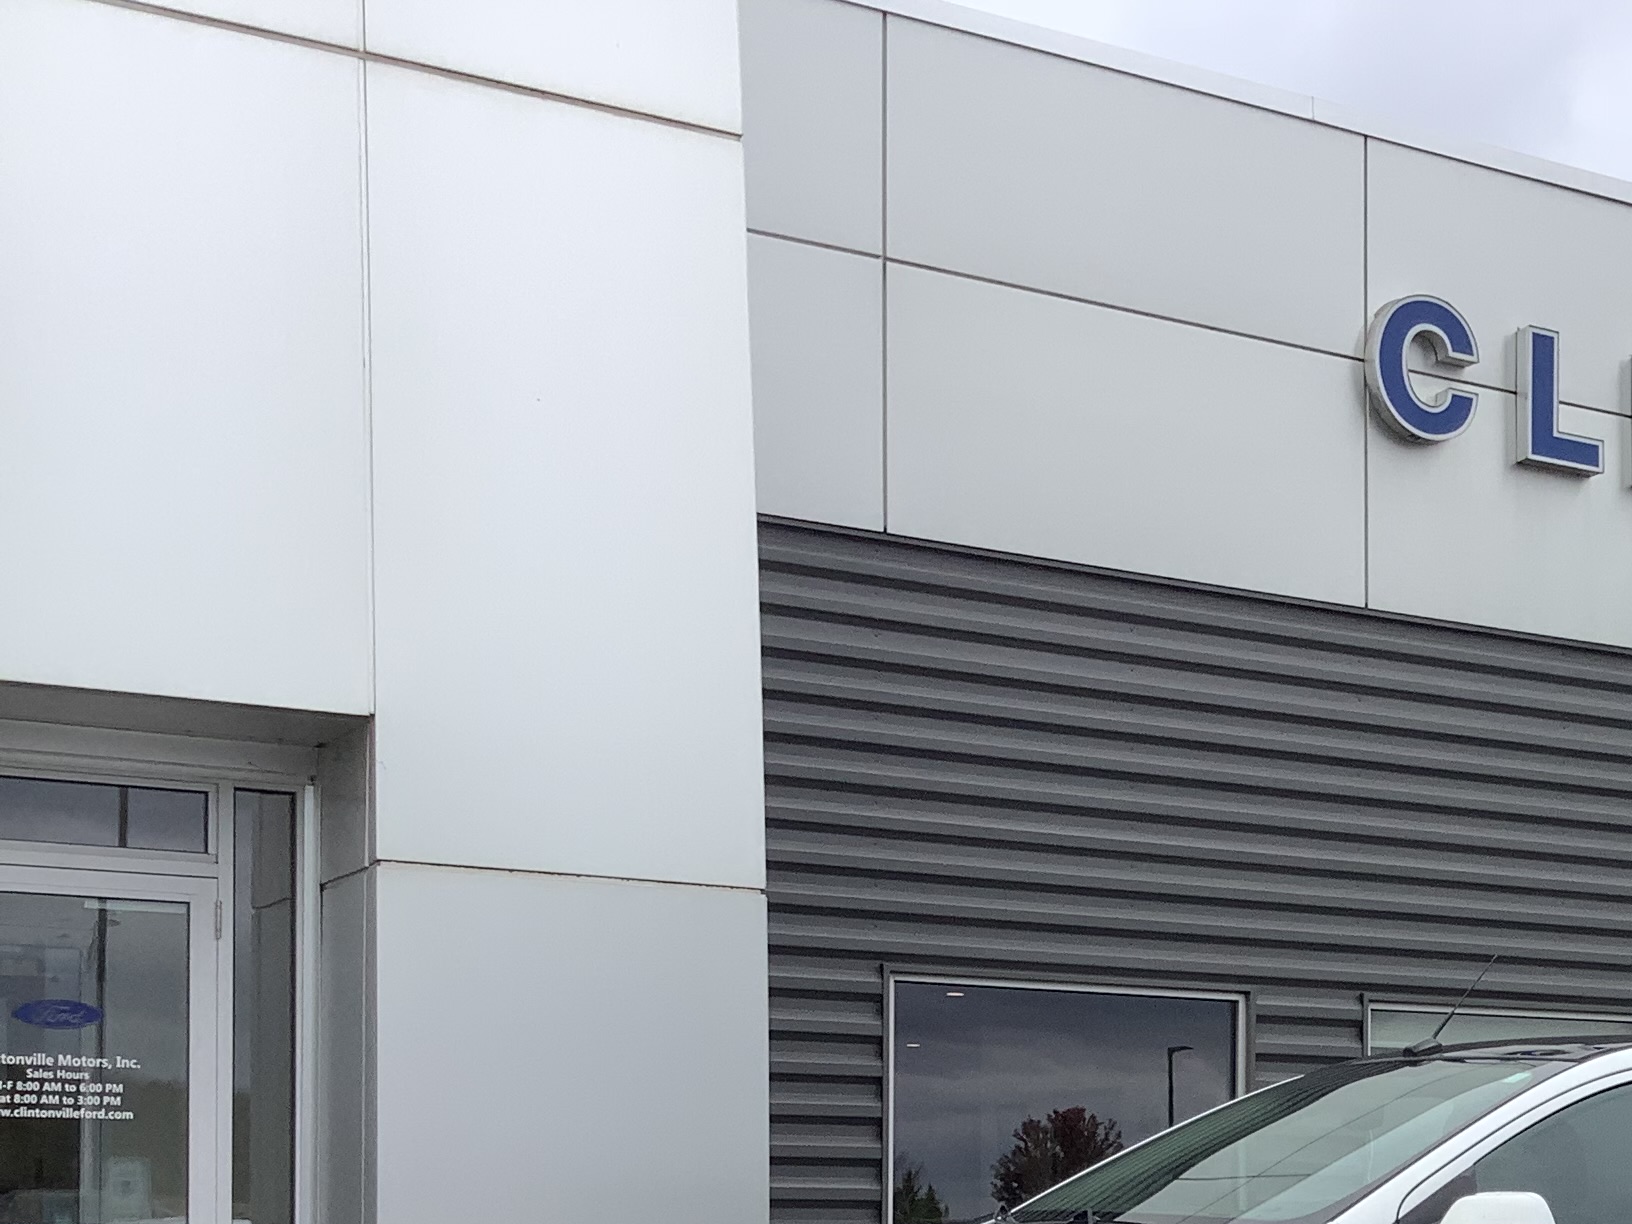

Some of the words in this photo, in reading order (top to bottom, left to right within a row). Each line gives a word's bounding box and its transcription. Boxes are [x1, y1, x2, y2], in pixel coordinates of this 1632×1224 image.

[0, 1053, 54, 1066] tonville
[58, 1054, 112, 1069] Motors,
[116, 1056, 141, 1069] Inc.
[26, 1068, 54, 1079] Sales
[57, 1069, 90, 1080] Hours
[0, 1081, 13, 1091] -F
[16, 1081, 40, 1091] 8:00
[42, 1082, 62, 1092] AM
[64, 1083, 77, 1093] to
[79, 1083, 103, 1093] 6:00
[105, 1083, 124, 1093] PM
[13, 1094, 38, 1104] 8:00
[40, 1095, 60, 1105] AM
[62, 1096, 75, 1105] to
[77, 1096, 101, 1106] 3:00
[103, 1096, 122, 1106] PM
[0, 1106, 134, 1120] w.clintonvilleford.com
